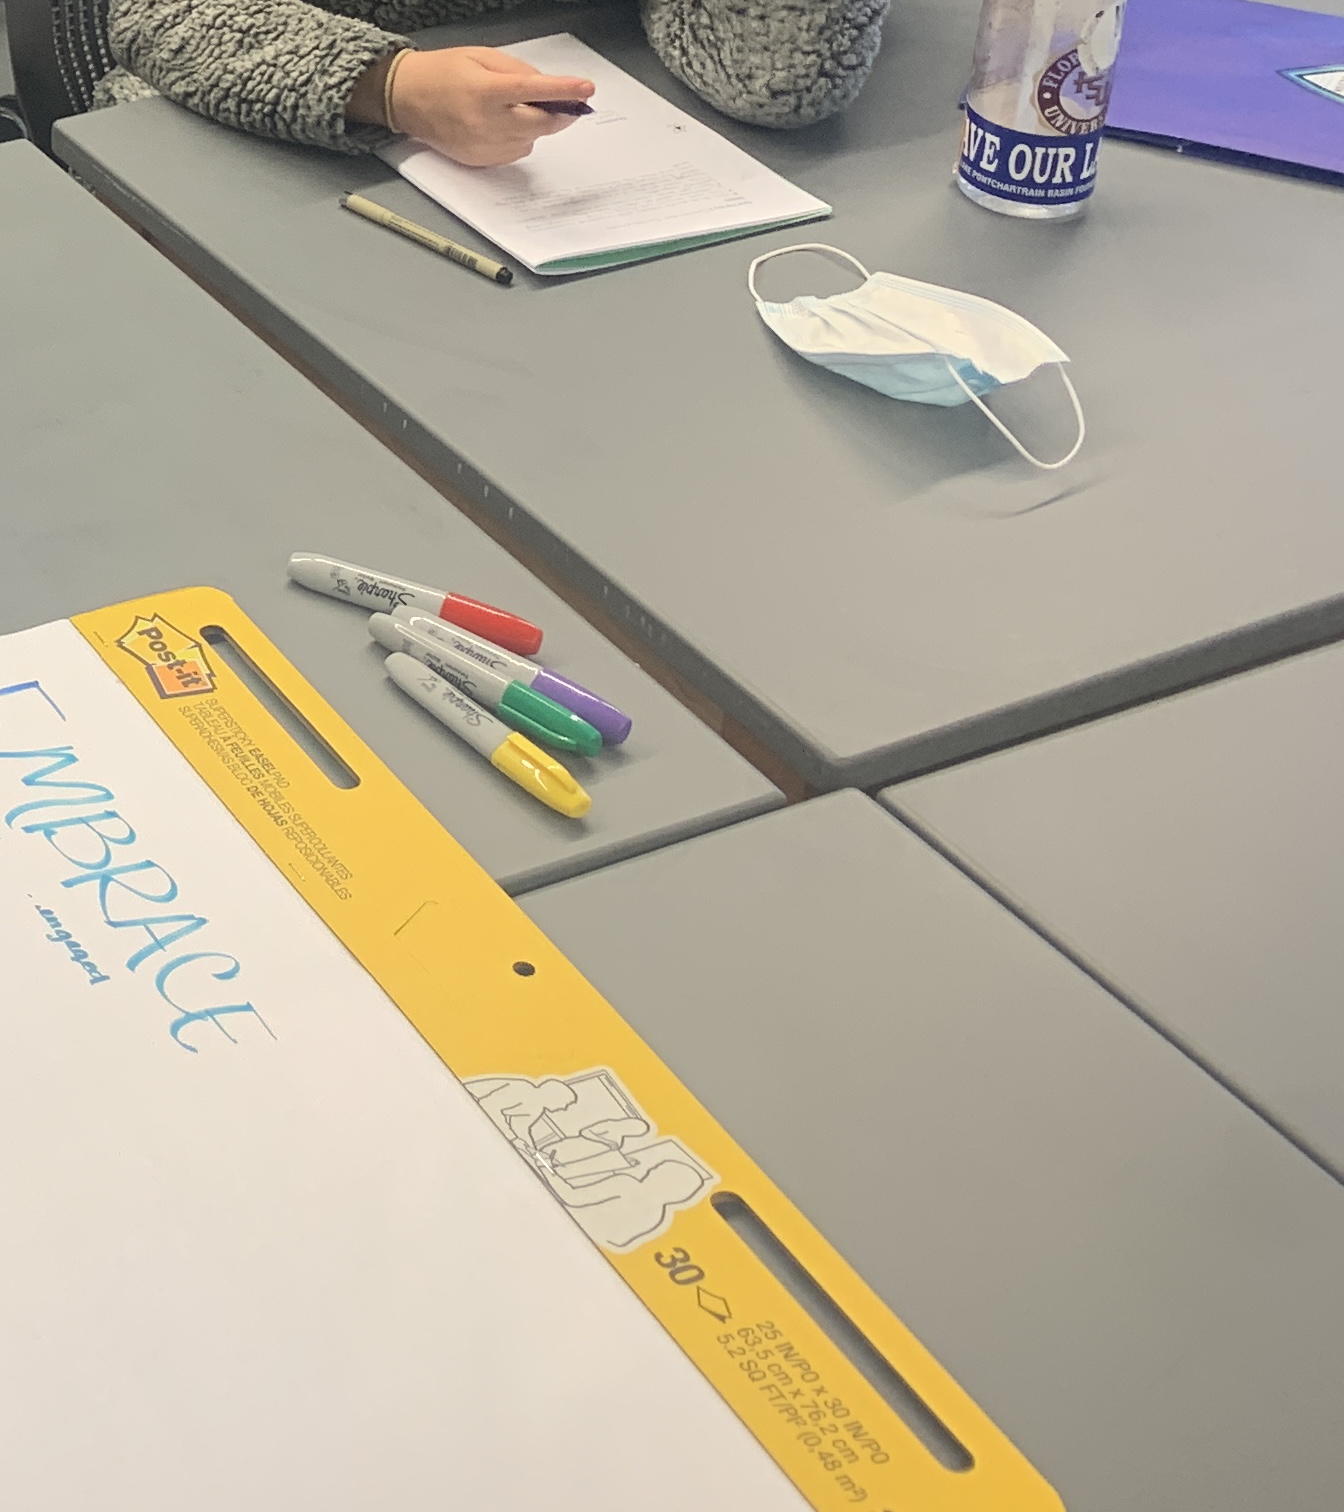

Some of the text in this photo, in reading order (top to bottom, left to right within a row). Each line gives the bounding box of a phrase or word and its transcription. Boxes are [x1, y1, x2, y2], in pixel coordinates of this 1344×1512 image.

[1008, 143, 1076, 184] OUR
[355, 577, 416, 608] Sharpie
[136, 625, 211, 690] Post-it
[441, 689, 494, 729] Sharpie
[227, 737, 266, 779] FEUILLES
[261, 773, 295, 816] MOBILES
[226, 760, 253, 788] BLOC
[245, 784, 263, 802] DE
[257, 796, 289, 828] HOJAS
[282, 824, 353, 901] REPOSICIONABLES
[34, 904, 111, 986] engaged
[653, 1246, 706, 1287] 30
[716, 1332, 747, 1359] 5.2
[739, 1359, 768, 1385] SQ
[736, 1326, 860, 1466] 63,5 cm x 76,2 cm
[755, 1320, 890, 1466] 25 IN/PO x 30 IN/PO
